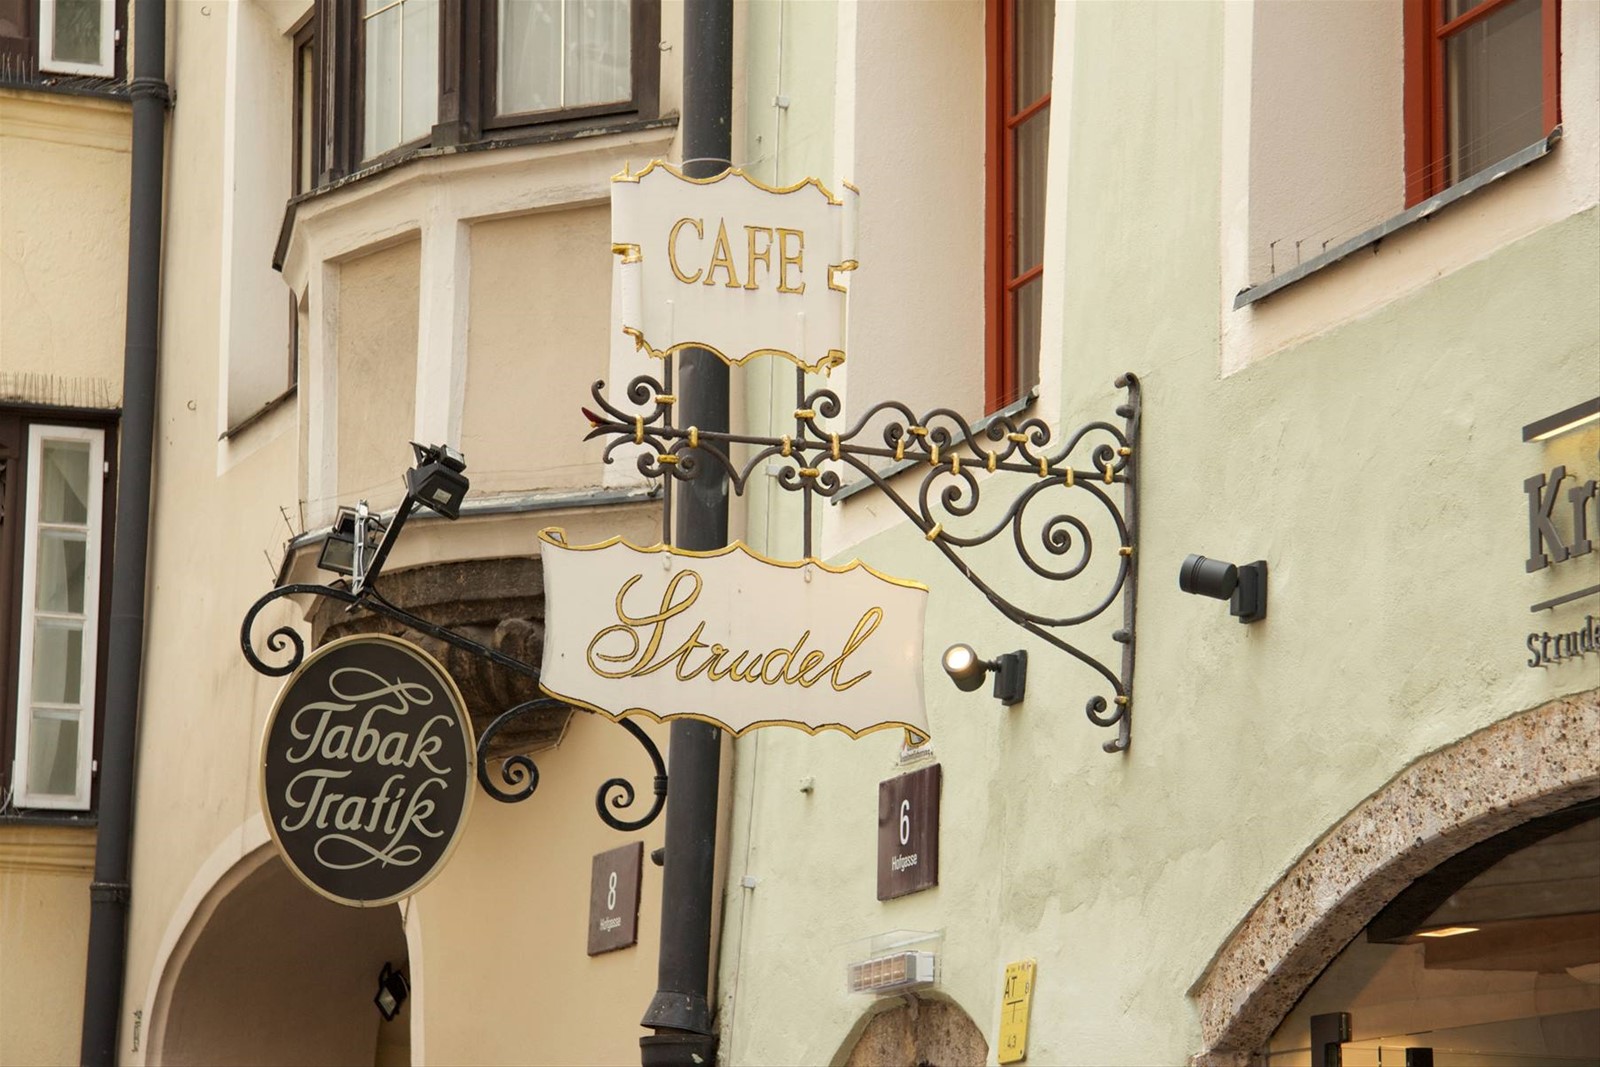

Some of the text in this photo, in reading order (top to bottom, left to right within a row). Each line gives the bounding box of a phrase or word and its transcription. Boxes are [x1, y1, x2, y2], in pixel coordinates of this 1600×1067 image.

[668, 217, 806, 295] CAFE
[1524, 464, 1600, 573] Kr
[586, 569, 884, 692] Strudel
[285, 667, 455, 775] Tabak
[281, 768, 448, 869] Trafik
[892, 854, 918, 872] Hofgasse
[900, 799, 910, 845] 6
[608, 871, 617, 911] 8
